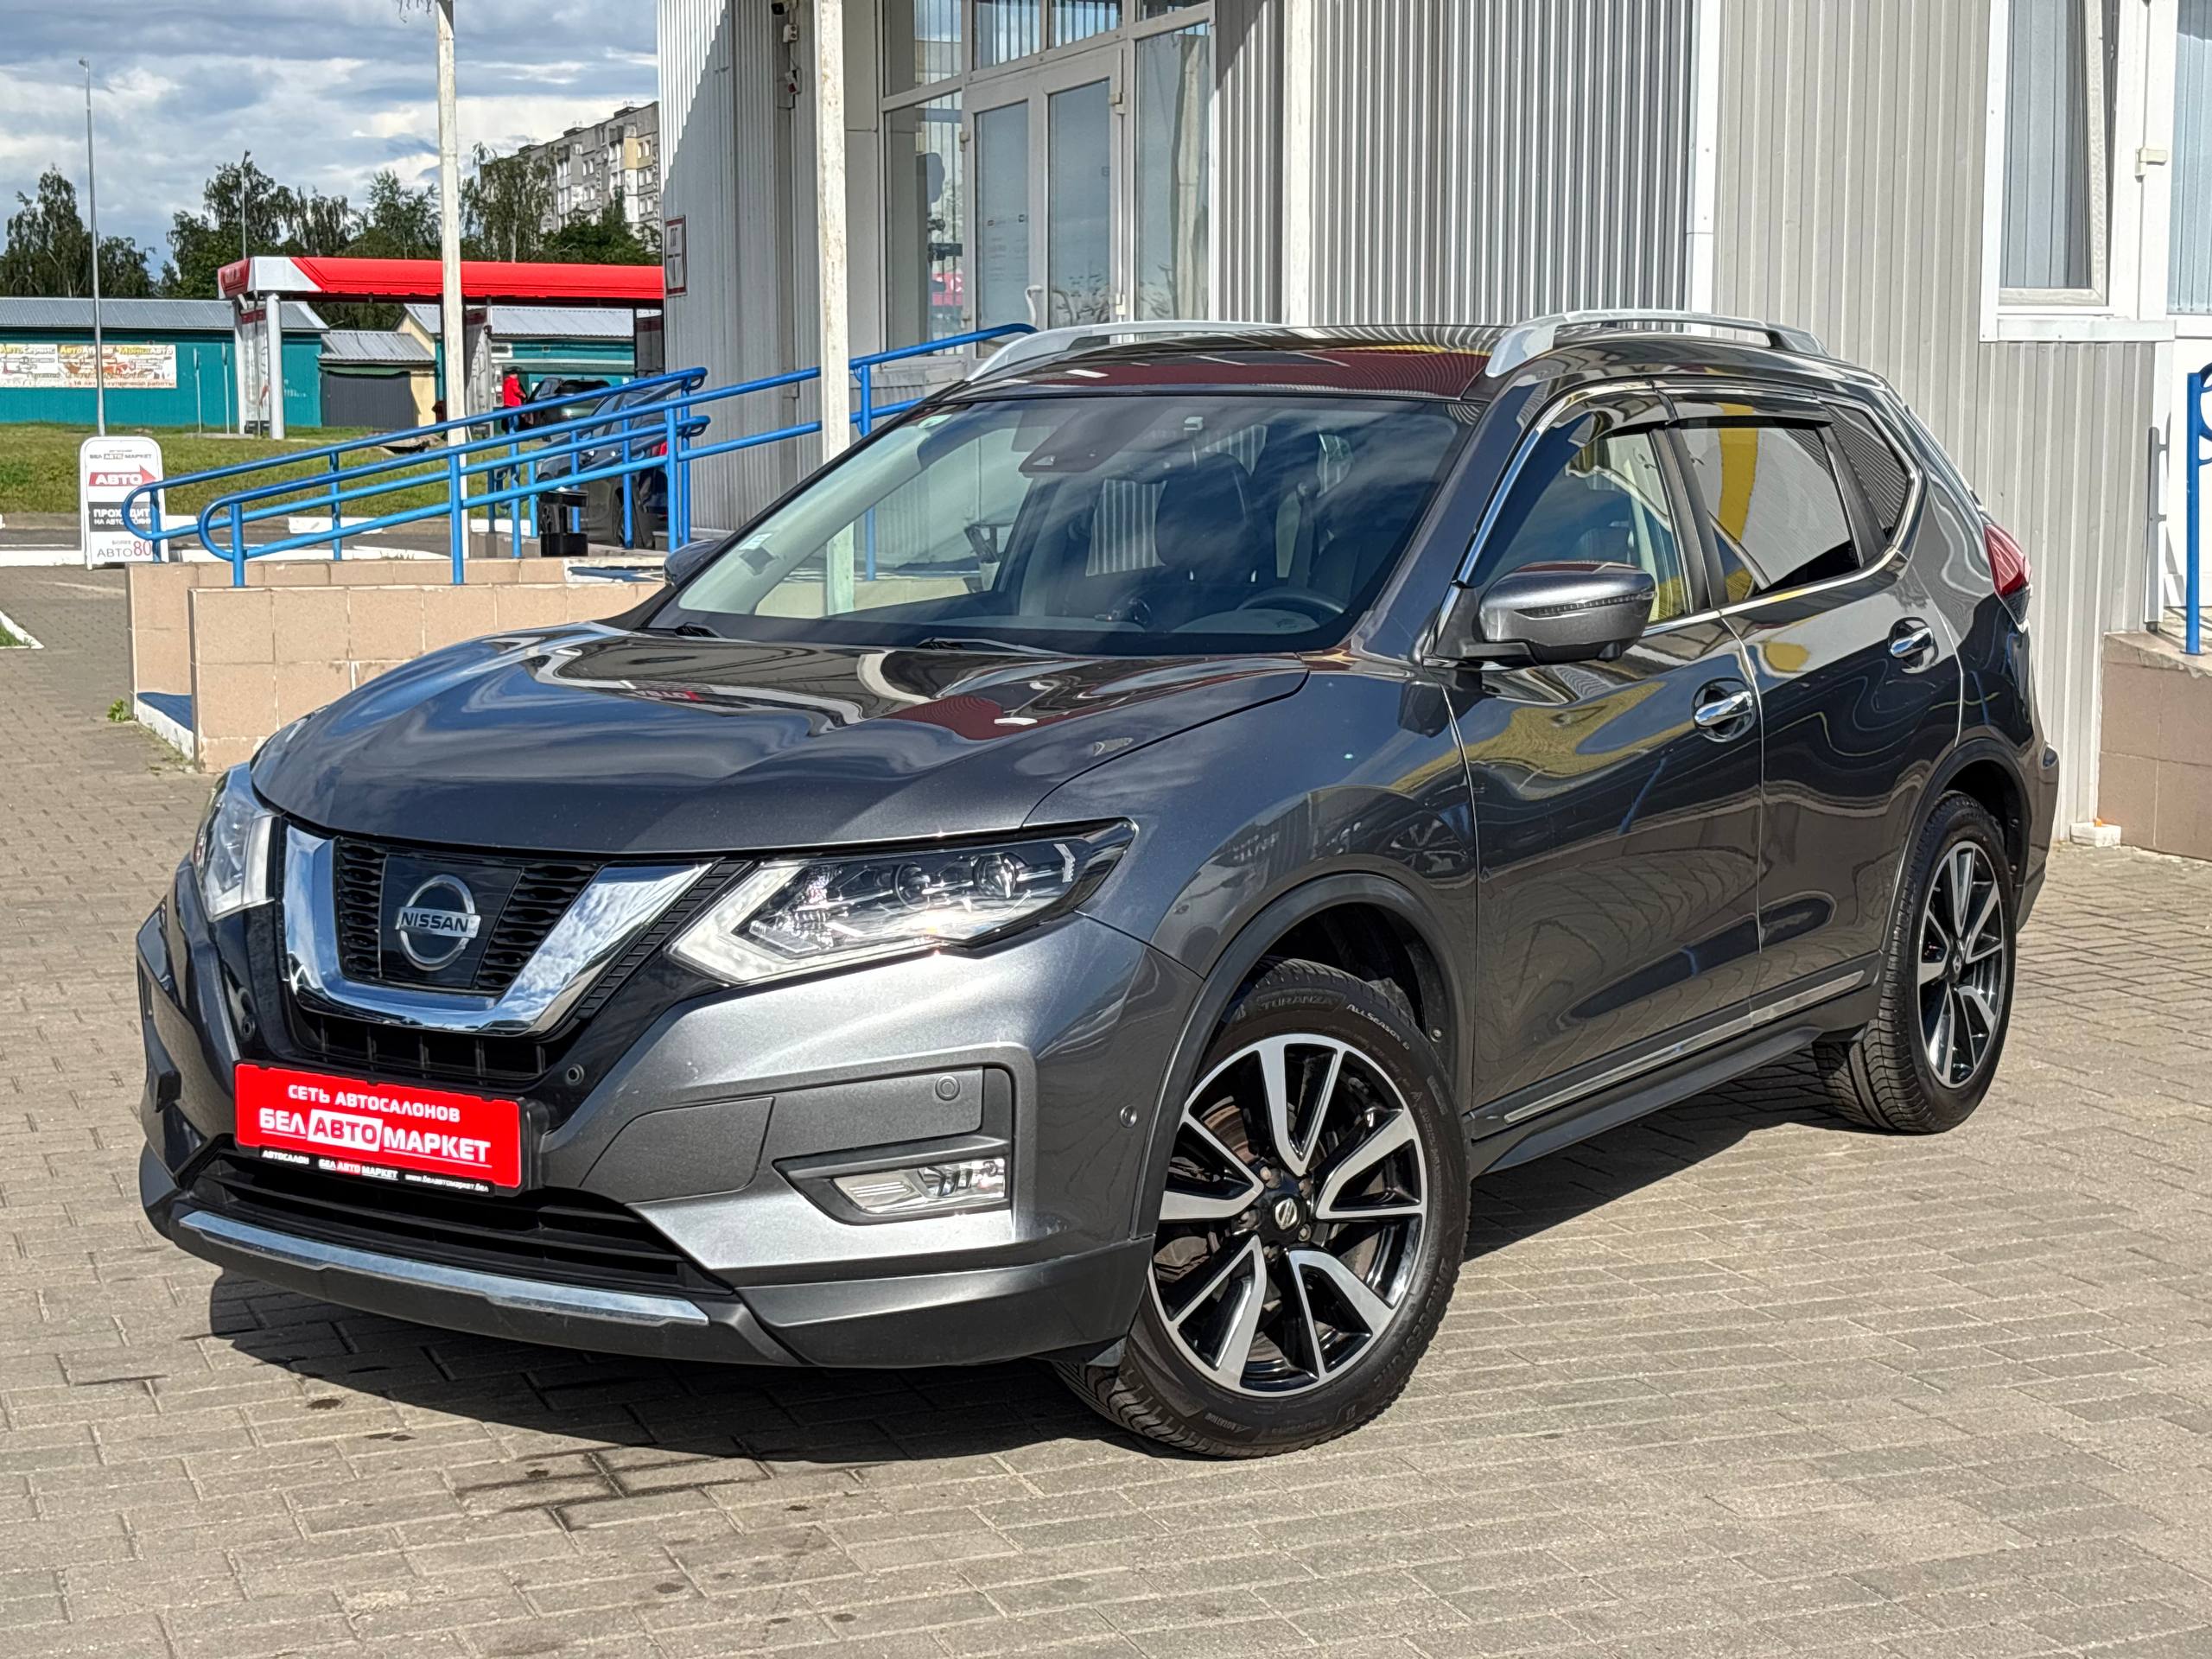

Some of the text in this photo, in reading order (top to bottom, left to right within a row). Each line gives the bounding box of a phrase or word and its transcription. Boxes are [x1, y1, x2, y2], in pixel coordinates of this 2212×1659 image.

[95, 474, 143, 486] АВТО
[97, 548, 132, 558] АВТО
[400, 912, 469, 933] NISSAN
[1258, 995, 1334, 1011] TURANZA
[288, 1084, 461, 1123] СЕТЬ АВТОСАЛОНОВ
[262, 1150, 309, 1165] АВТОСАЛОН
